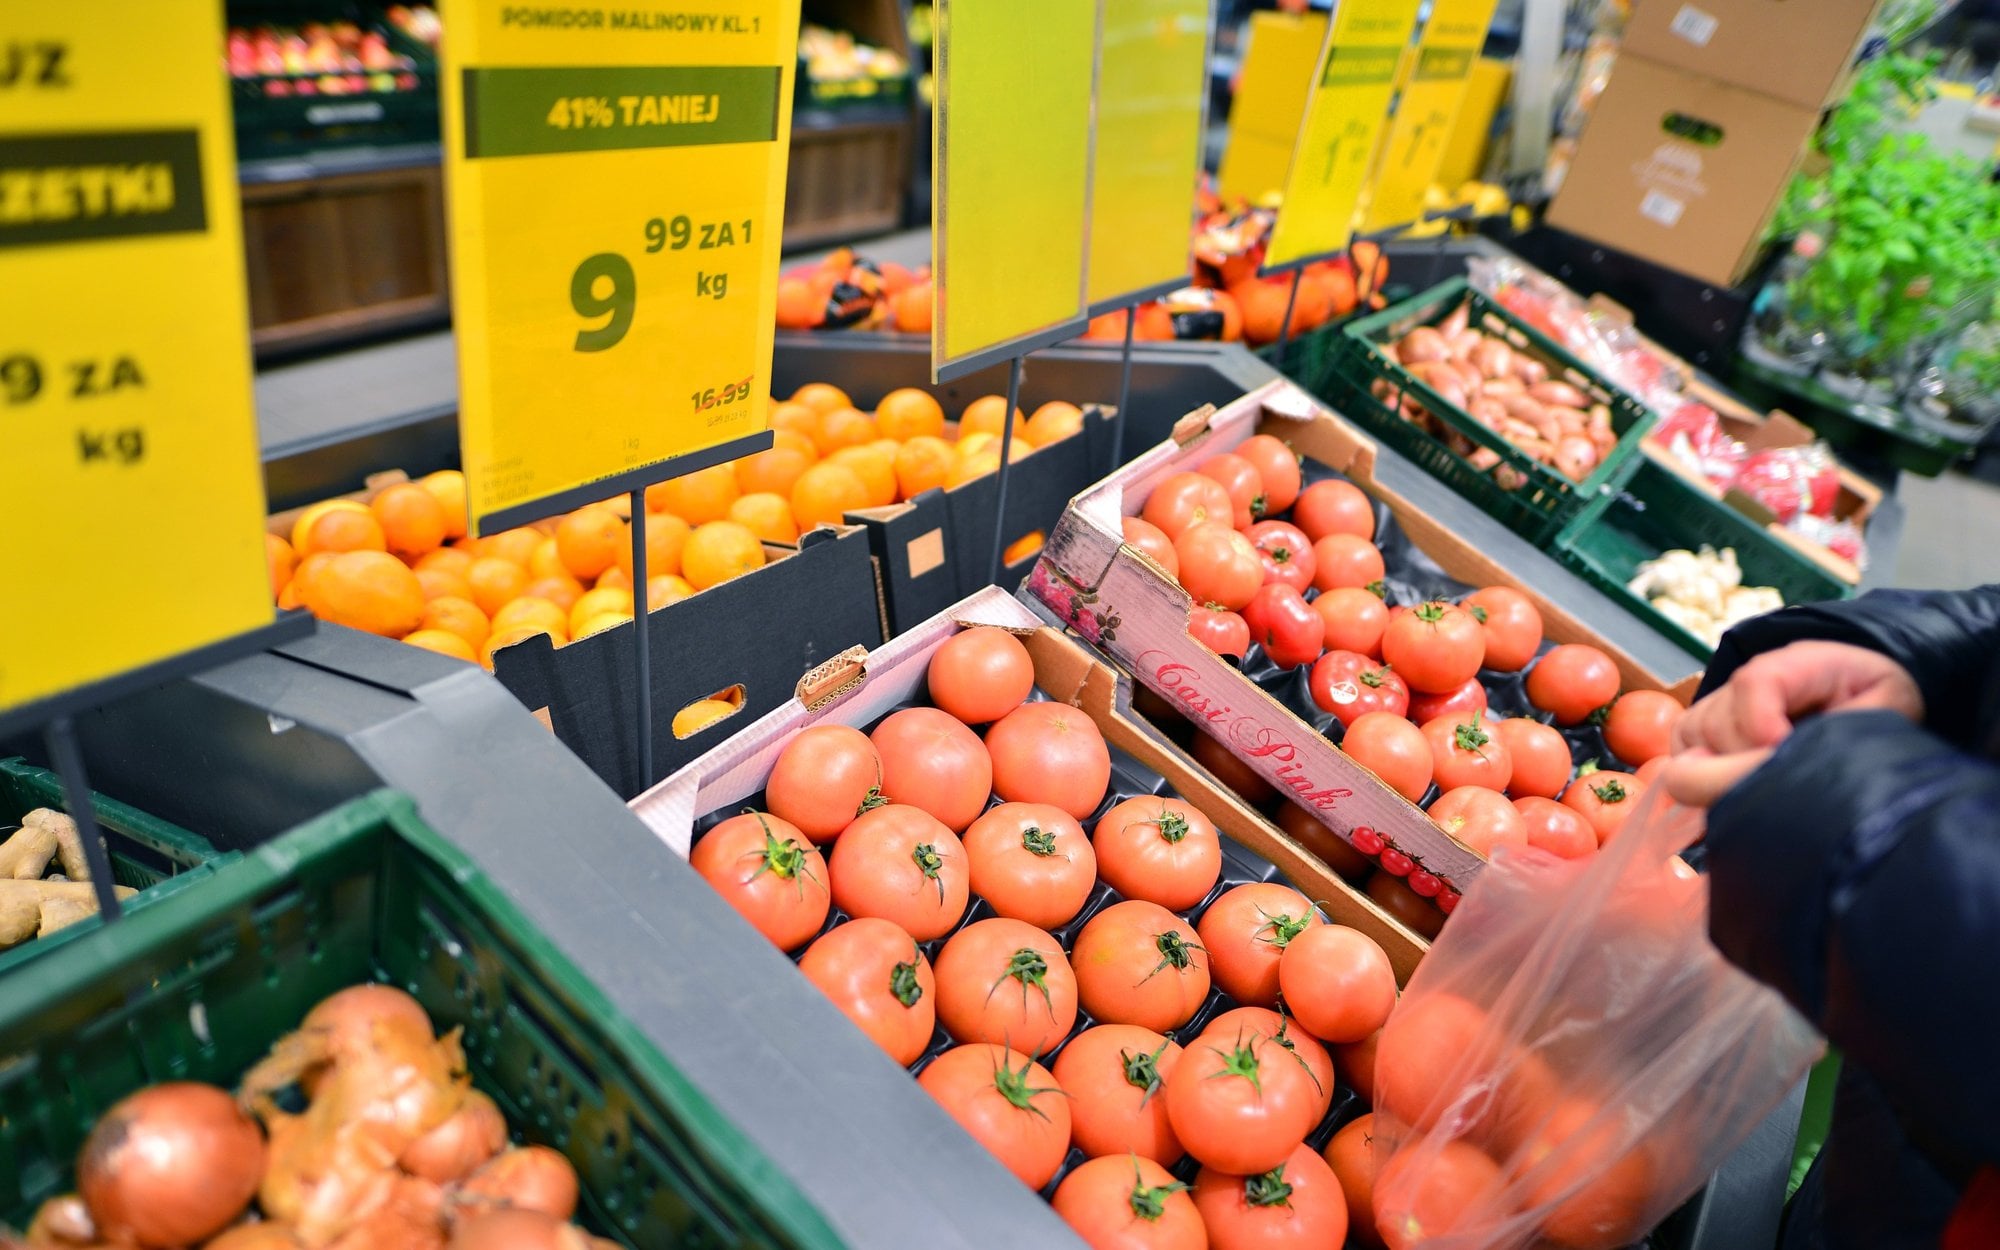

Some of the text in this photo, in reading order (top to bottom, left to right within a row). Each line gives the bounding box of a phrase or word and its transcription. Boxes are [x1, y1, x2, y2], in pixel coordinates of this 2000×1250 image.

[501, 8, 760, 33] POMIDOR MALINOWY KL. 1
[547, 94, 720, 129] 41% TANIEJ
[571, 215, 752, 353] 9 99 ZA 1
[696, 271, 728, 300] kg
[66, 356, 148, 400] ZA
[691, 382, 751, 410] 16.99
[77, 426, 146, 467] kg
[1136, 650, 1353, 810] Casi Pink
